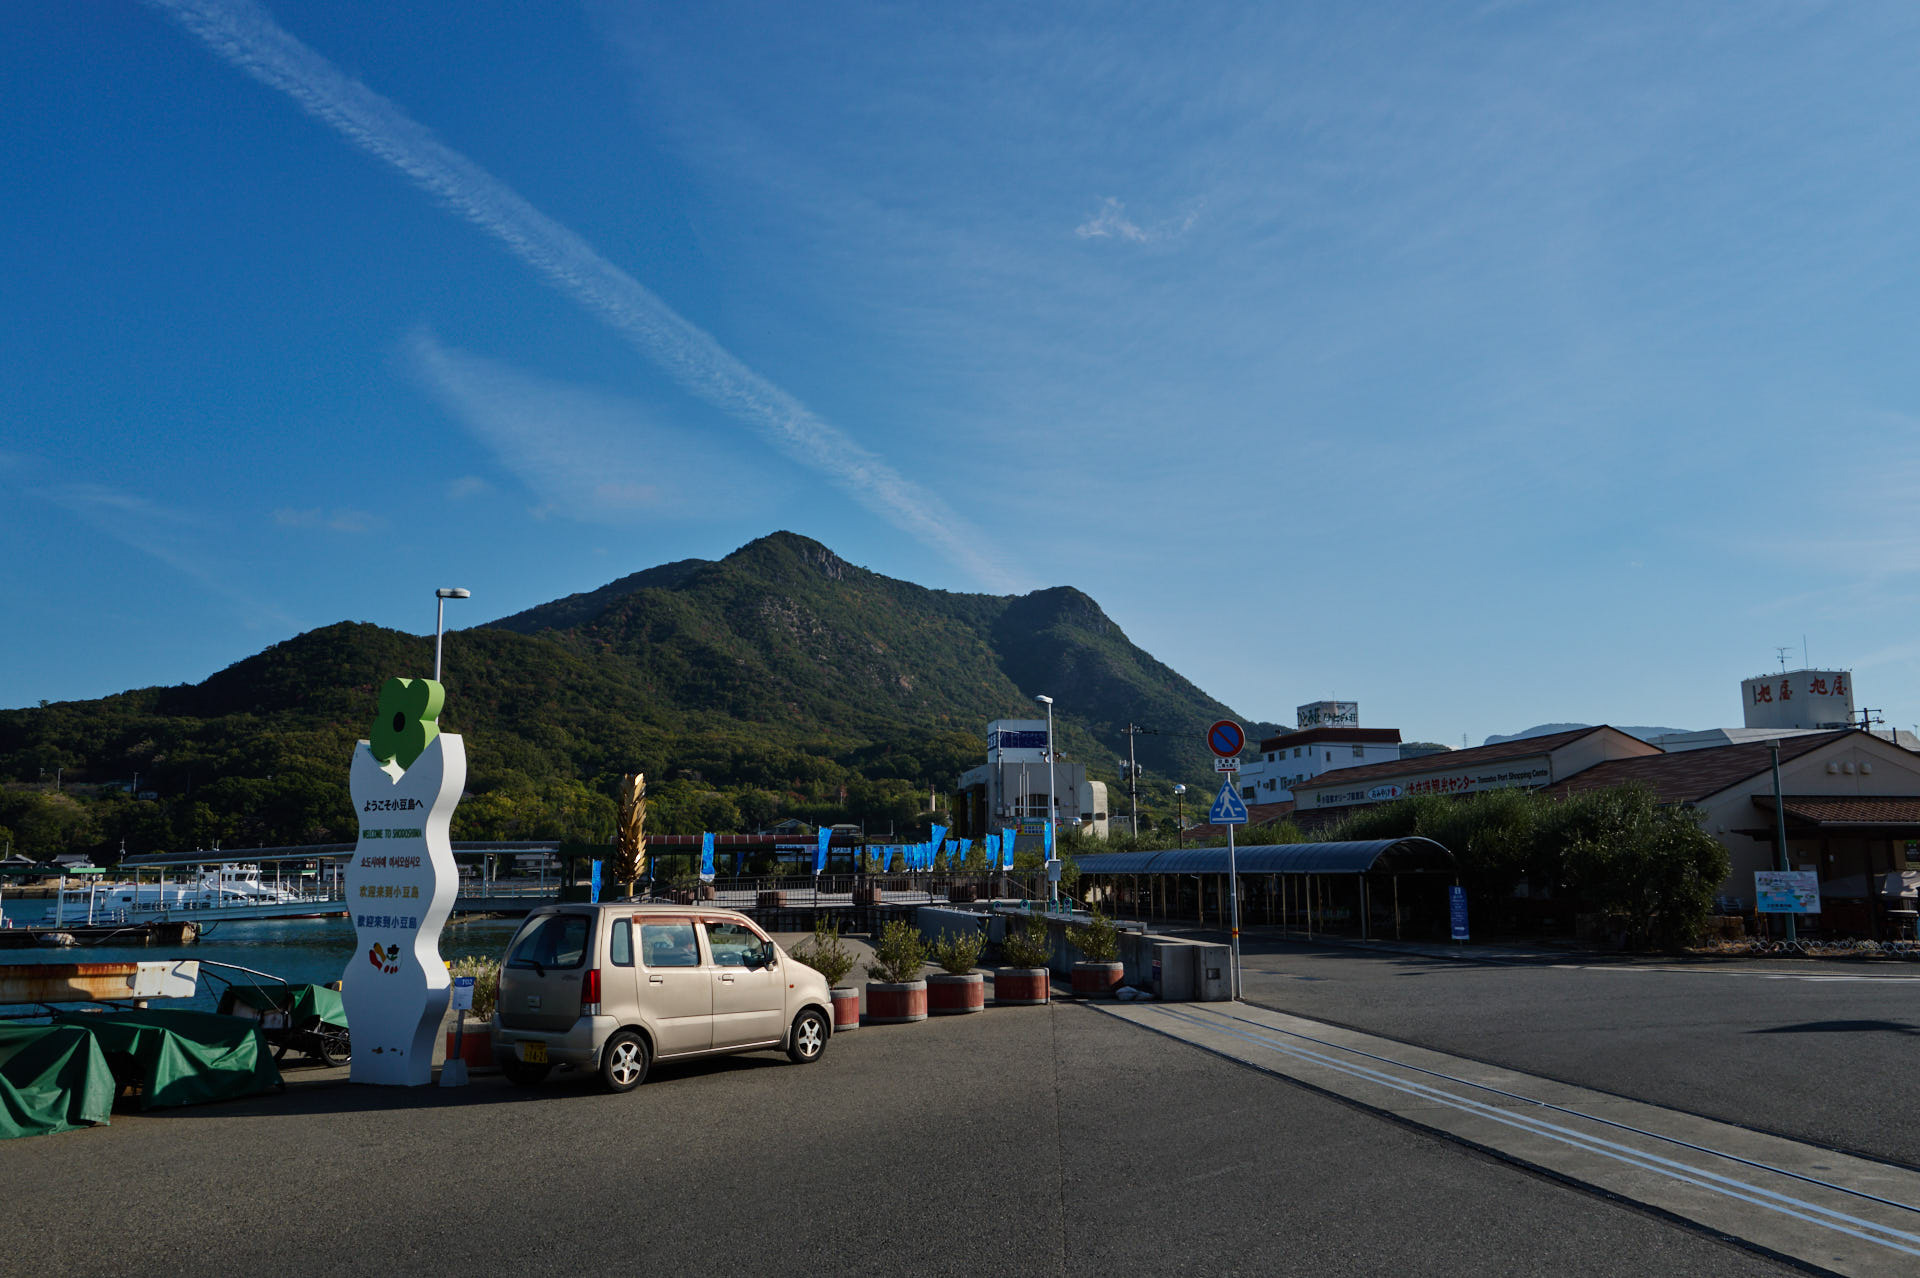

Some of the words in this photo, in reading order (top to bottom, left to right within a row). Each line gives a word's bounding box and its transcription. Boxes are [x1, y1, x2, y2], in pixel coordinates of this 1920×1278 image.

[1809, 675, 1847, 696] 旭屋
[1497, 773, 1508, 781] Port
[1508, 770, 1532, 780] Shopping
[363, 798, 424, 812] ようこそ小豆島へ
[362, 829, 383, 839] WELCOME
[384, 829, 392, 839] TO
[392, 828, 422, 839] SHODOSHIMA
